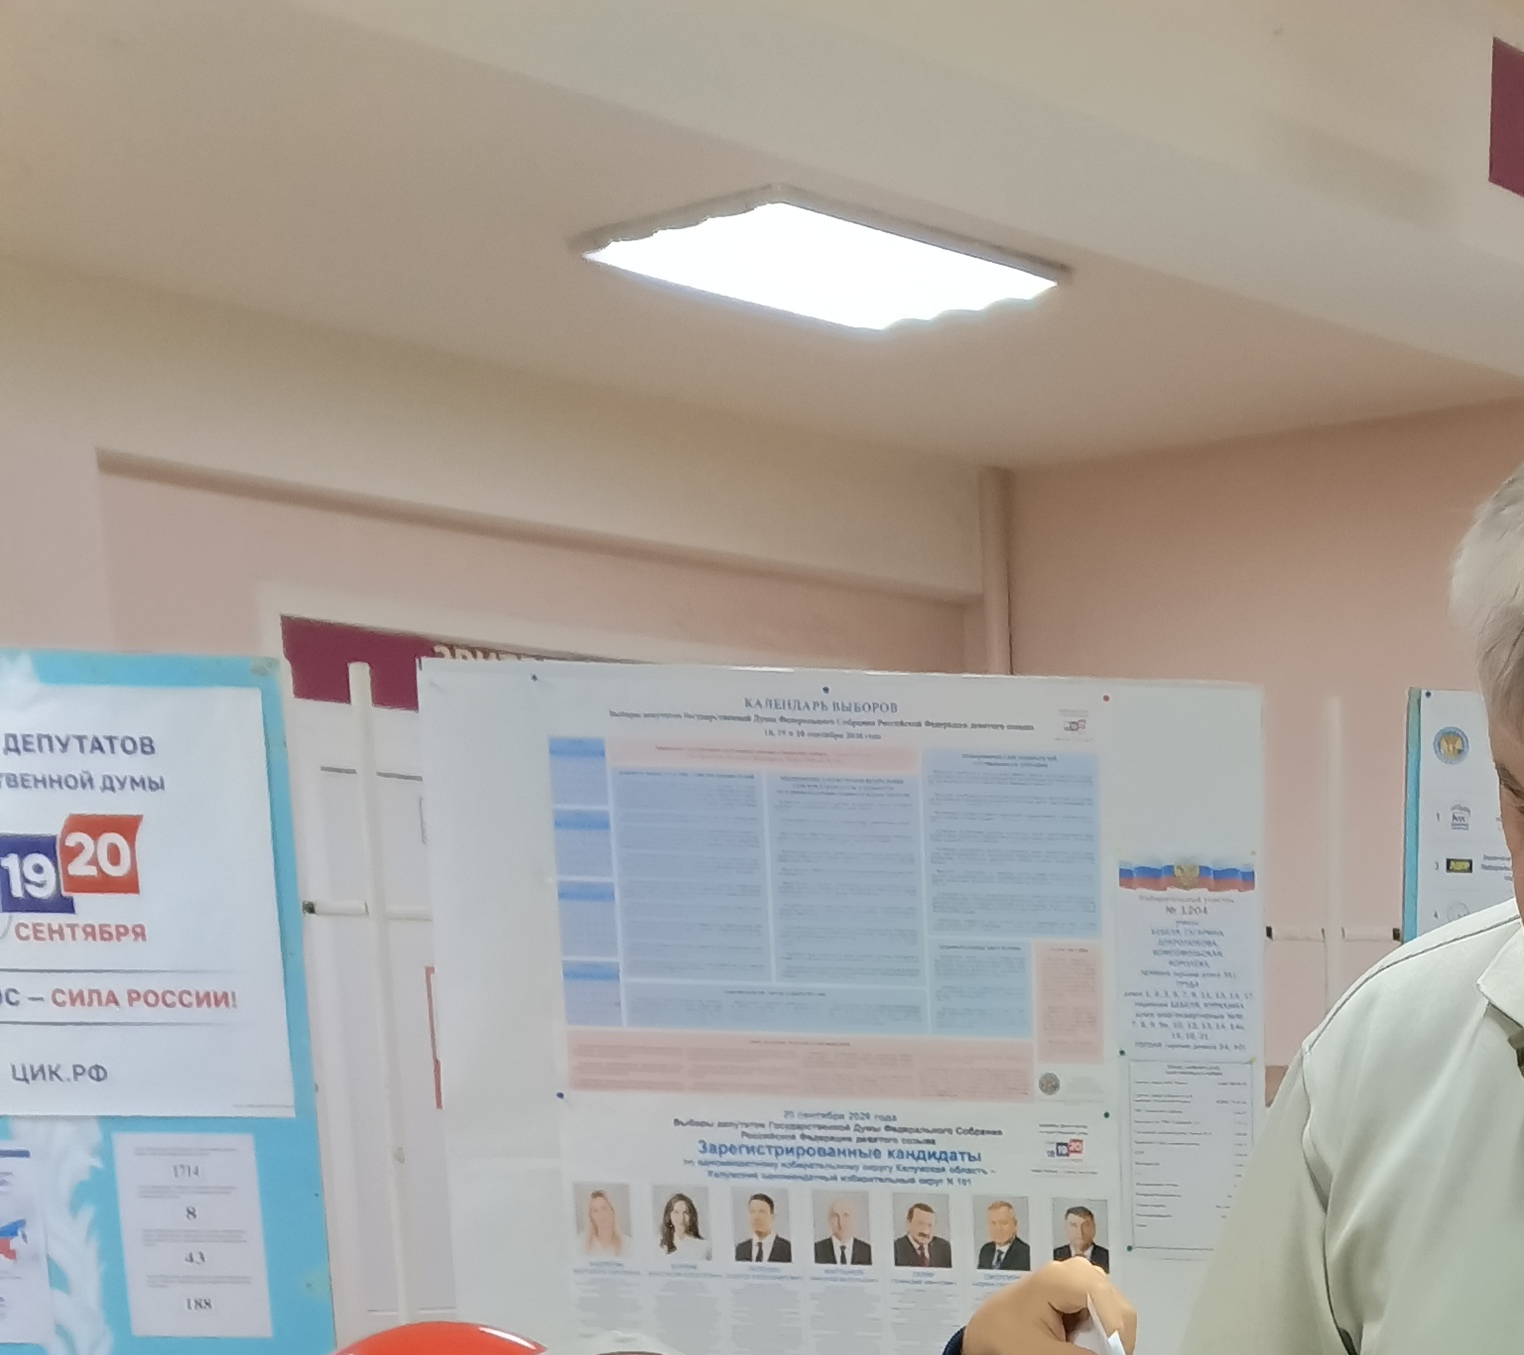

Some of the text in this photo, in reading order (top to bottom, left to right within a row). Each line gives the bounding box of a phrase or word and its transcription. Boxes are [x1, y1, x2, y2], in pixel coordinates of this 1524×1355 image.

[3, 732, 156, 757] ДЕПУТАТОВ
[0, 769, 166, 794] ВЕННОЙ ДУМЫ
[65, 832, 132, 878] 20
[0, 853, 57, 900] 19
[14, 922, 148, 943] СЕНТЯБРЯ
[51, 988, 120, 1008] СИЛА
[126, 989, 238, 1010] РОССИИ!
[10, 1063, 108, 1085] ЦИК.РФ
[698, 1139, 982, 1163] Зарегистрированные кандидаты
